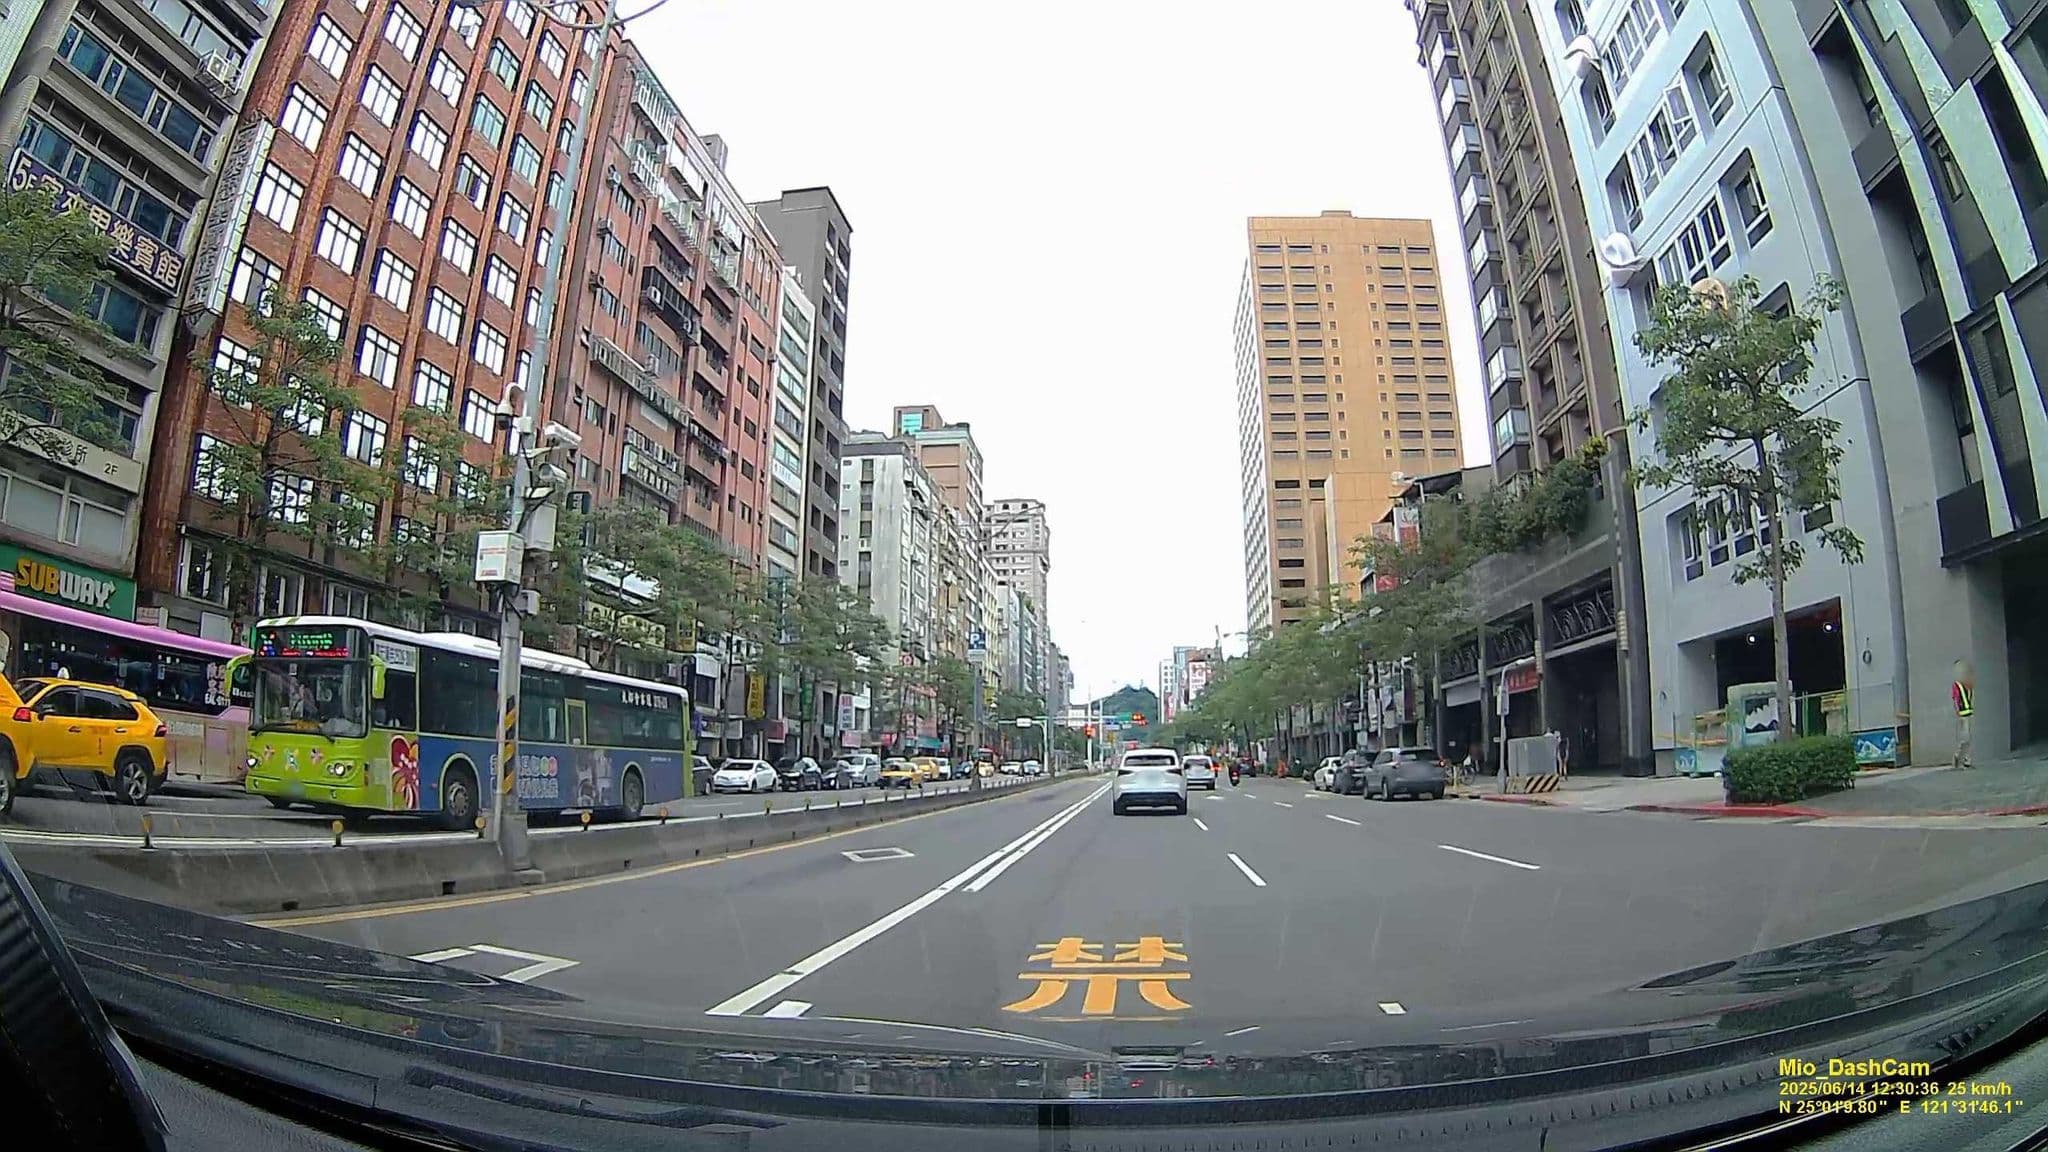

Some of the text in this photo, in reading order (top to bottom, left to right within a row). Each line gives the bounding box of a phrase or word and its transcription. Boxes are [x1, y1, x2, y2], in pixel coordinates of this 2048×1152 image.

[103, 463, 118, 476] 2F
[15, 557, 116, 610] SUBWAY
[1001, 936, 1192, 1015] 禁
